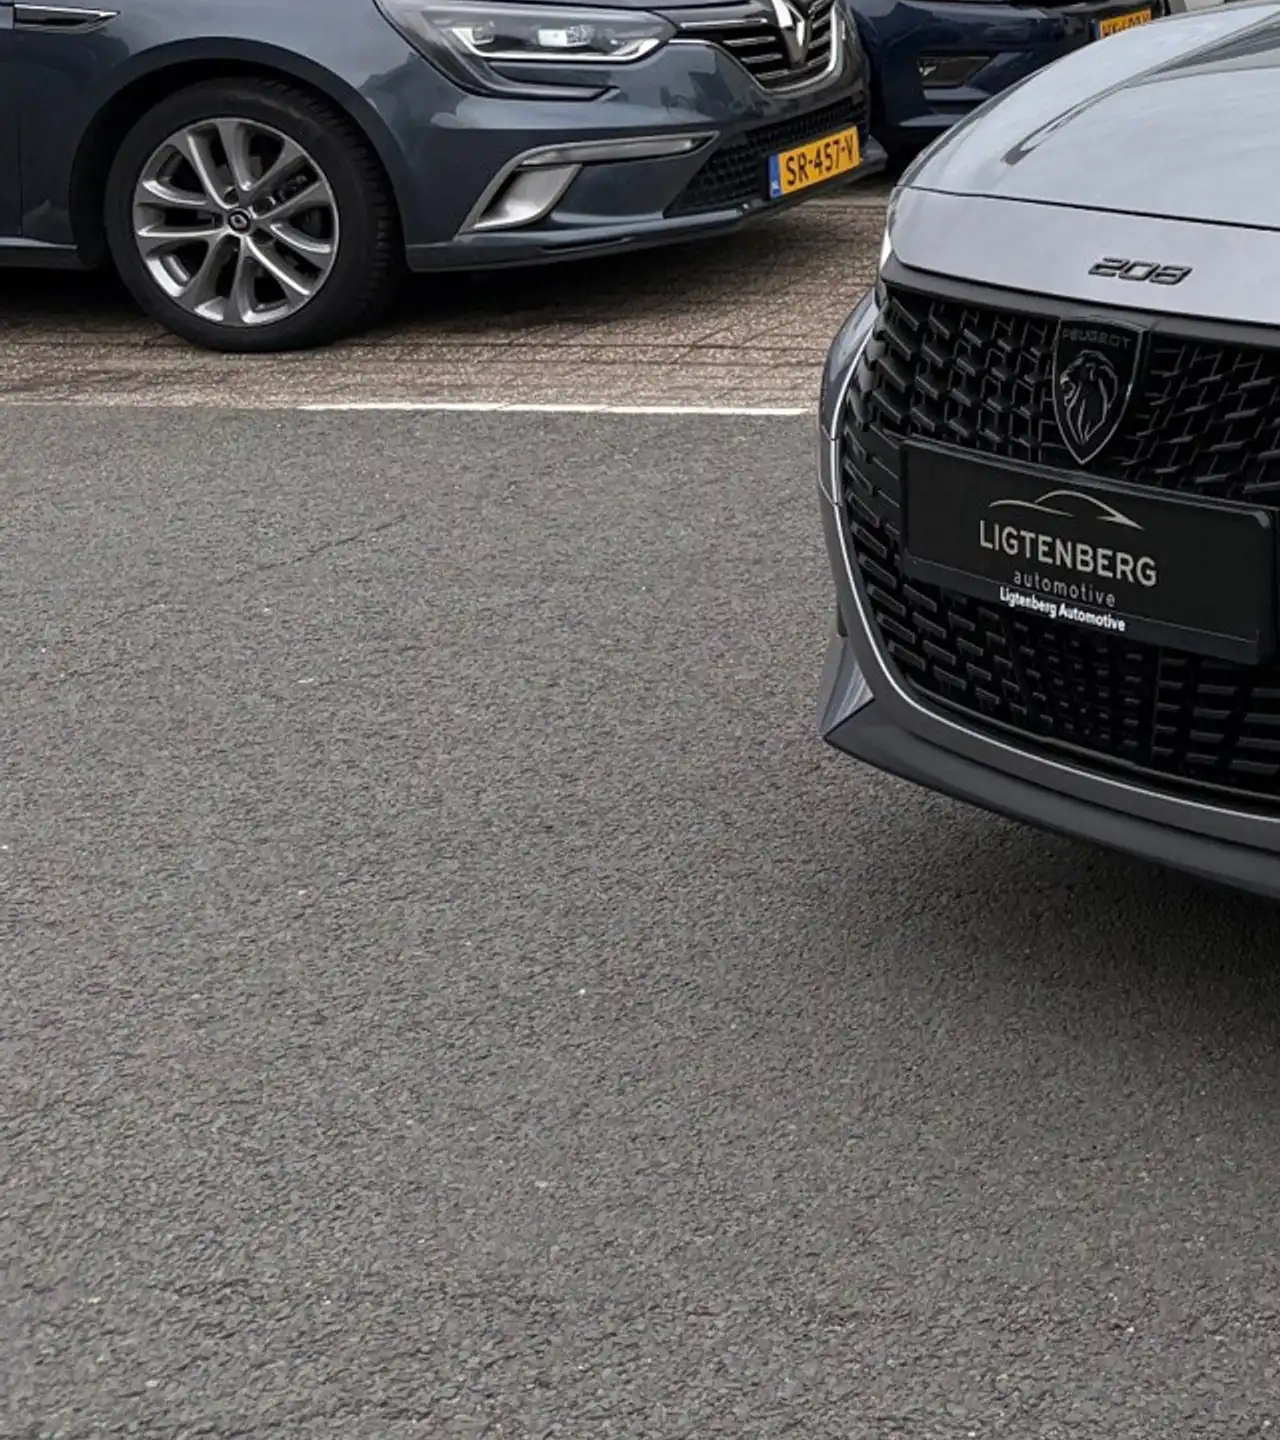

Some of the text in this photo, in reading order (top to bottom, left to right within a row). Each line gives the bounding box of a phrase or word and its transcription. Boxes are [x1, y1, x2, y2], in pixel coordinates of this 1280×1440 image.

[1088, 257, 1193, 285] 208
[1061, 326, 1133, 348] PEUGEOT
[979, 519, 1158, 587] LIGTENBERG
[1013, 569, 1117, 608] automotive
[999, 585, 1126, 632] Ligtenberg Automotive
